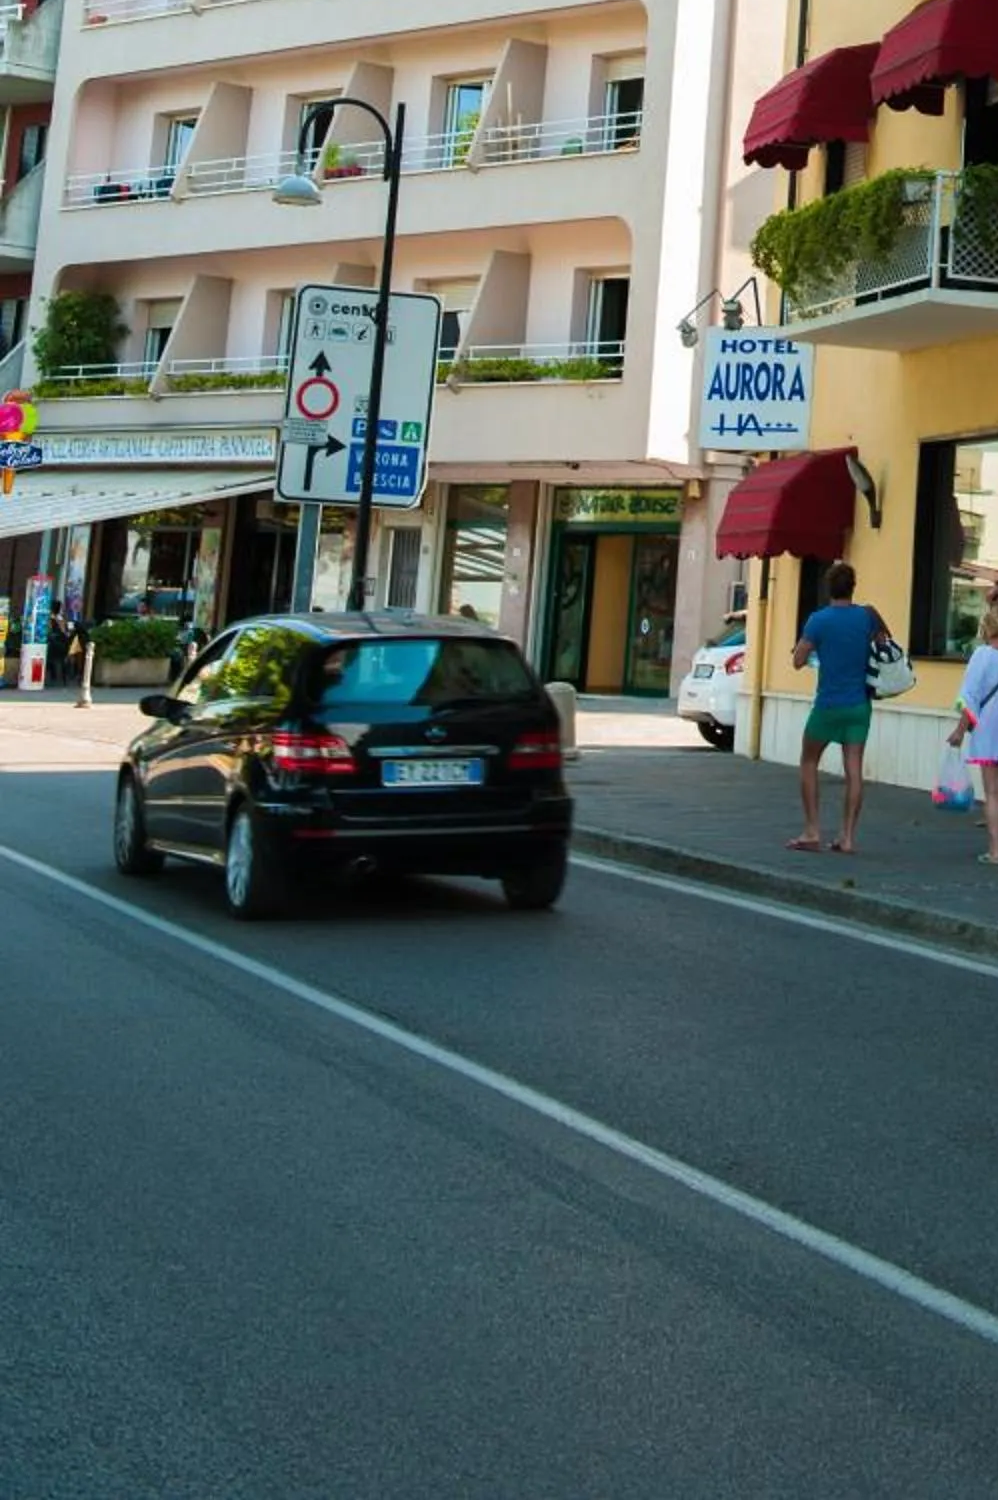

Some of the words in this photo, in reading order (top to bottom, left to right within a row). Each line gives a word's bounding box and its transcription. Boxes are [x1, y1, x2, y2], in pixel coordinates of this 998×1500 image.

[721, 339, 799, 354] HOTEL
[707, 362, 805, 401] AURORA
[355, 450, 408, 467] VRONA
[353, 471, 411, 488] BESCIA
